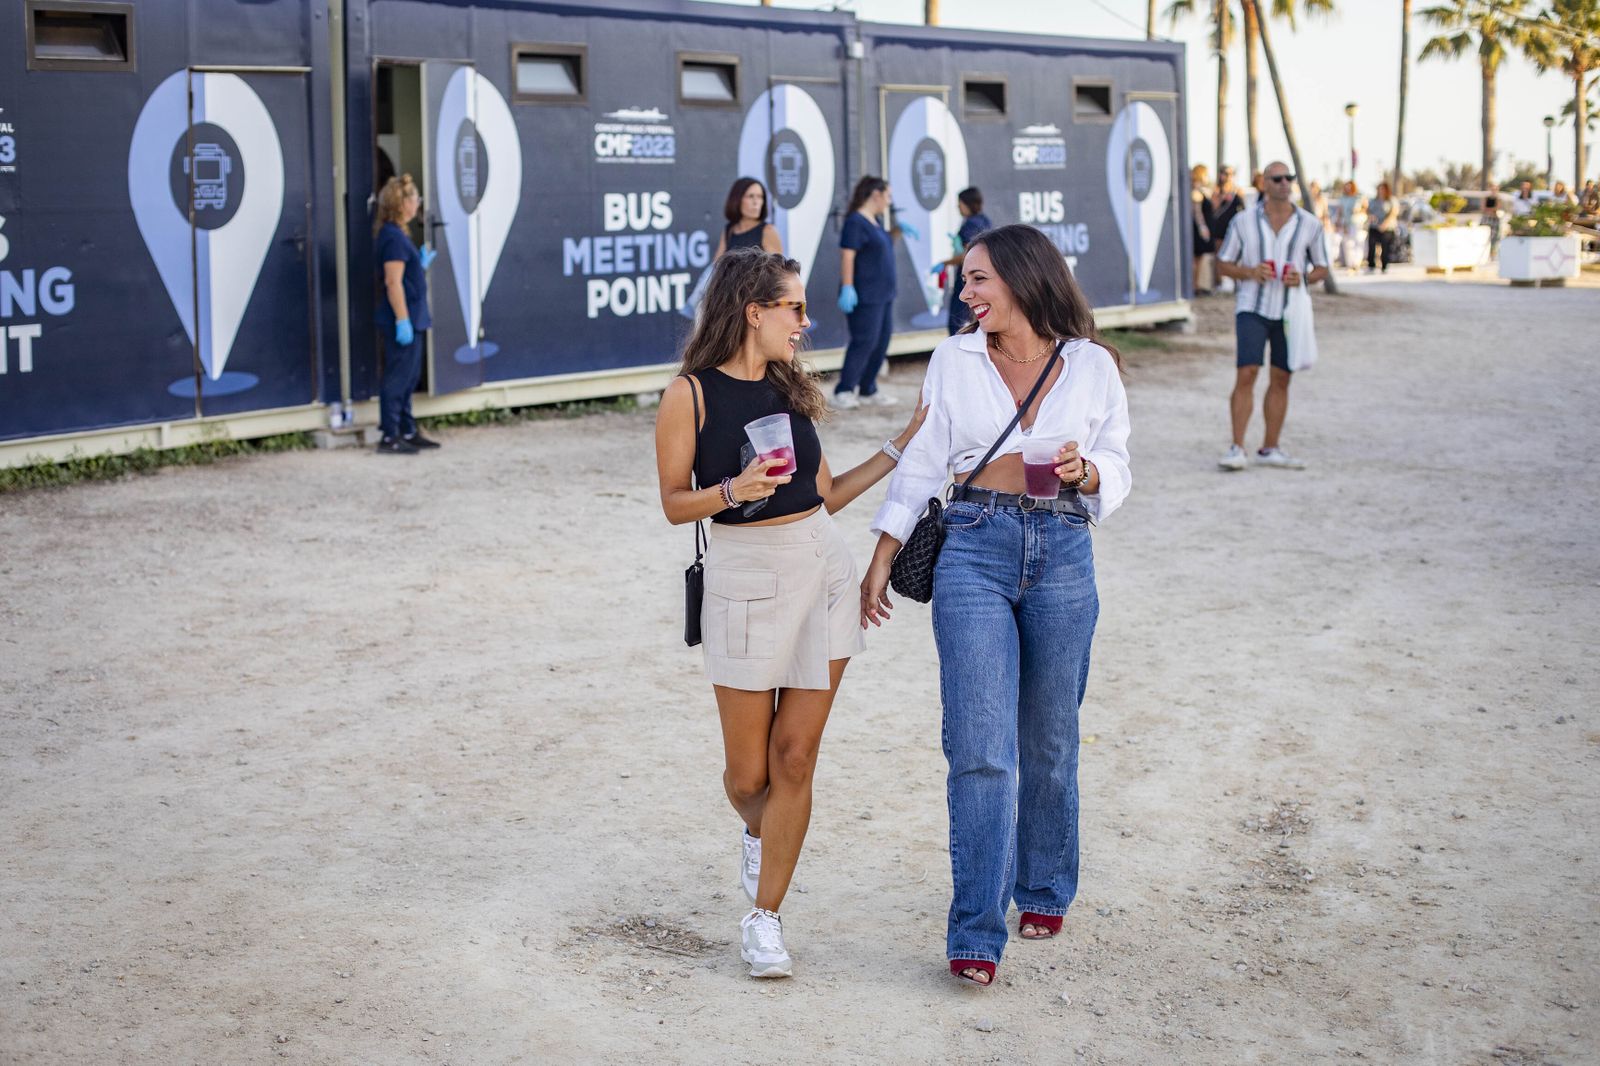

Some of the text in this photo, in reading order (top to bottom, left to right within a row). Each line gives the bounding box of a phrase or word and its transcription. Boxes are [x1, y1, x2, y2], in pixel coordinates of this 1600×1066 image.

[594, 133, 676, 156] CMF2023
[603, 191, 673, 231] BUS
[1018, 190, 1064, 223] BUS
[562, 231, 710, 276] MEETING
[587, 273, 691, 318] POINT
